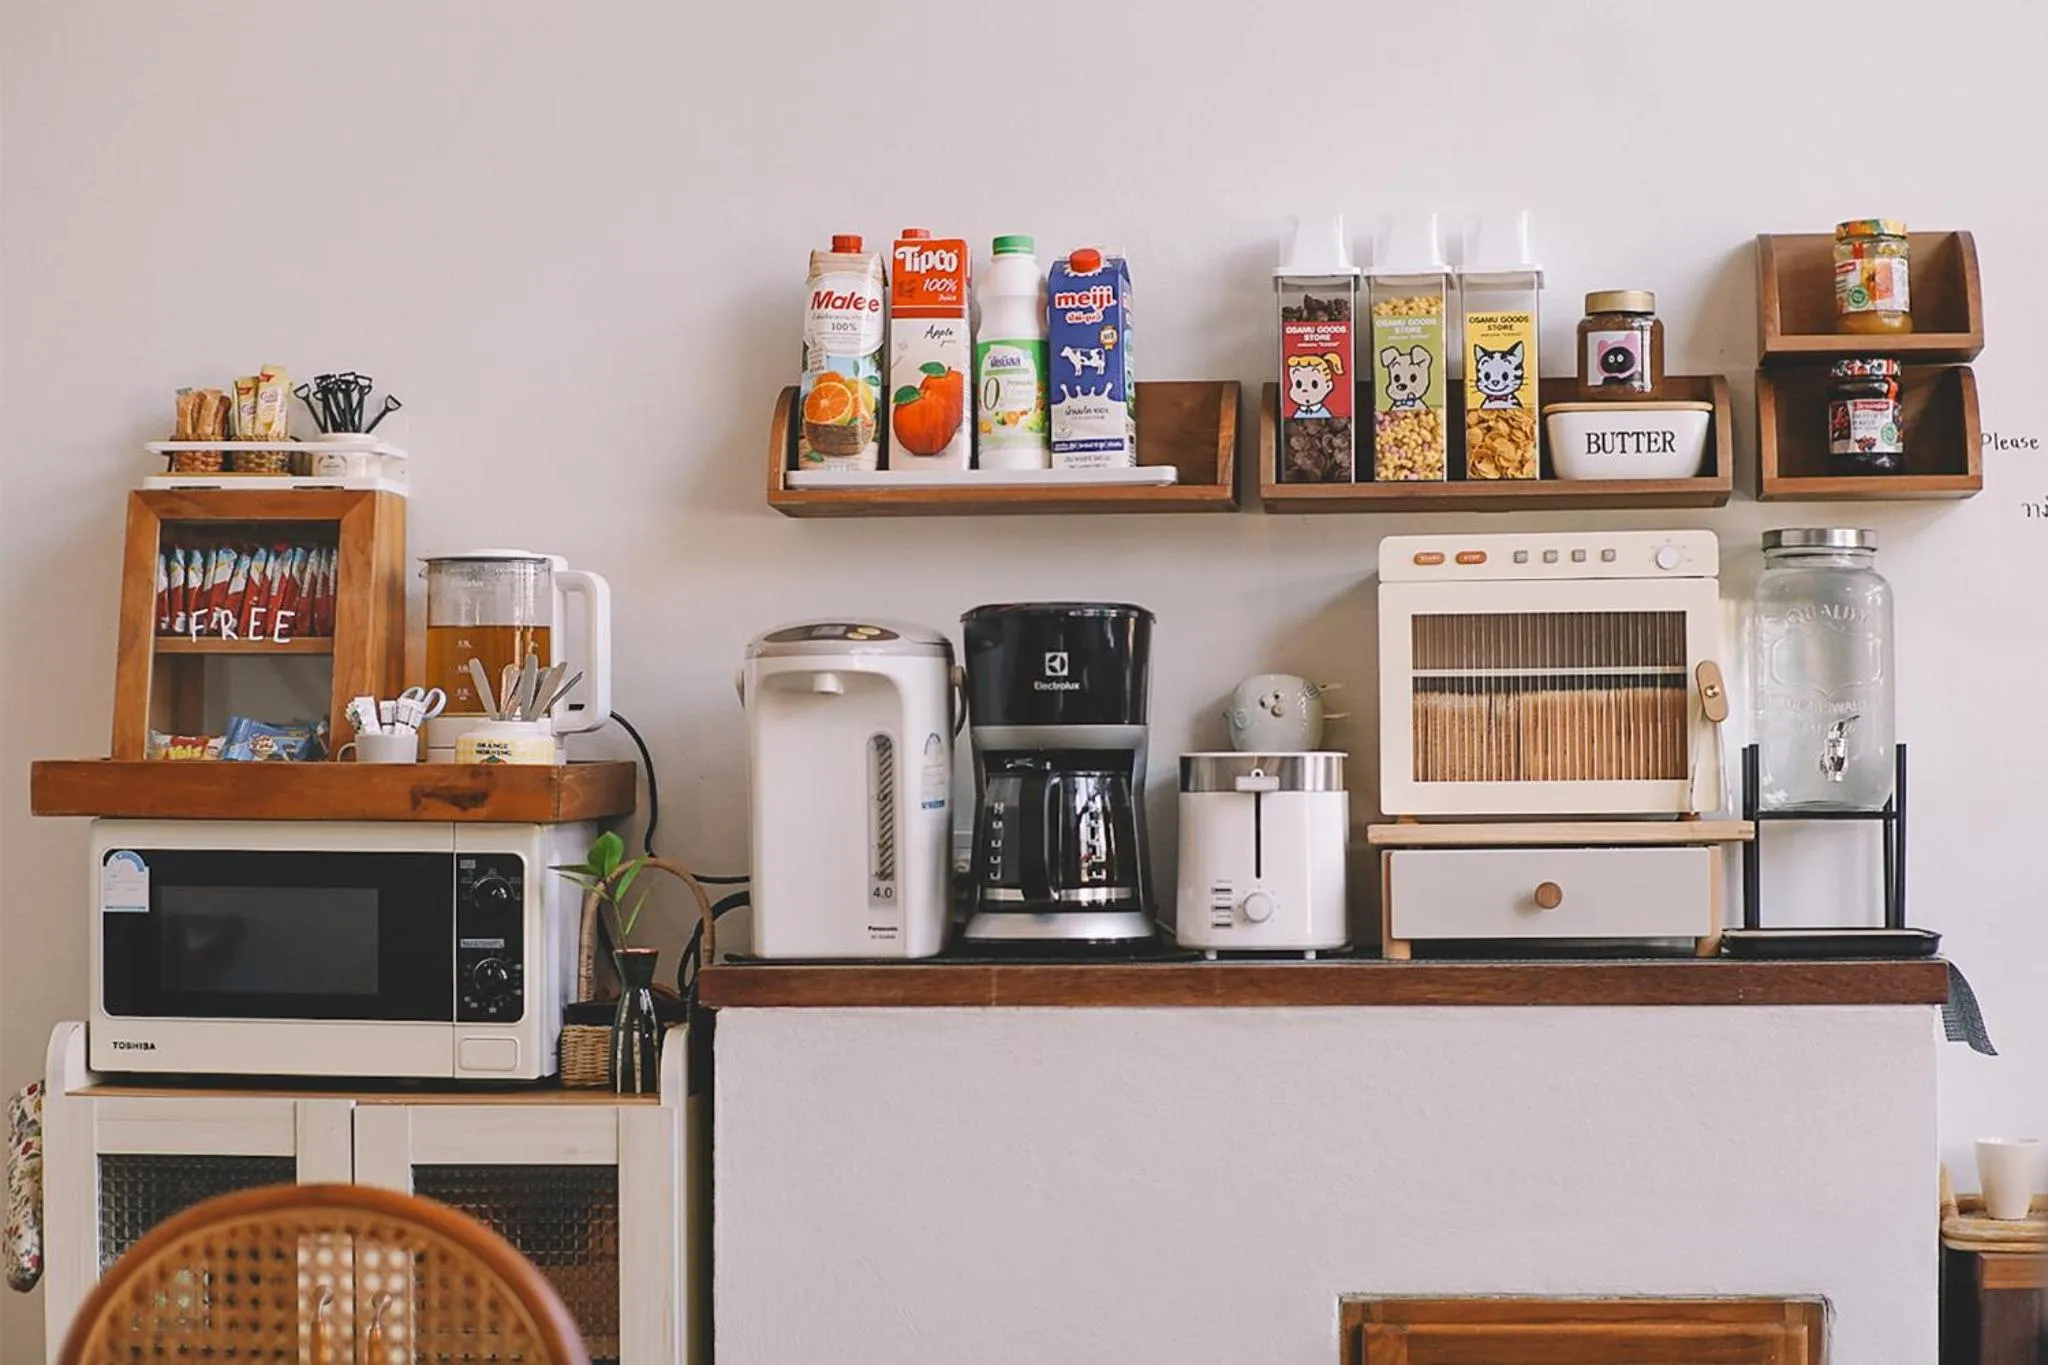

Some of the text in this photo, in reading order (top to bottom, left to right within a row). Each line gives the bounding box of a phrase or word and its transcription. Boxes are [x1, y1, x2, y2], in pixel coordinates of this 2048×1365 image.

[895, 246, 958, 274] Tipco
[923, 278, 957, 292] 100%
[811, 290, 880, 313] Malee
[1055, 286, 1112, 310] meiji
[831, 322, 857, 331] 100%
[1500, 315, 1529, 323] GOODS
[924, 324, 953, 340] Apple
[1316, 325, 1347, 334] GOODS
[1585, 431, 1676, 456] BUTTER
[1981, 432, 2040, 451] Please
[190, 608, 296, 644] FREE
[1034, 681, 1081, 691] Electrolux
[873, 886, 893, 899] 4.0
[112, 1041, 156, 1050] TOSHIBA
